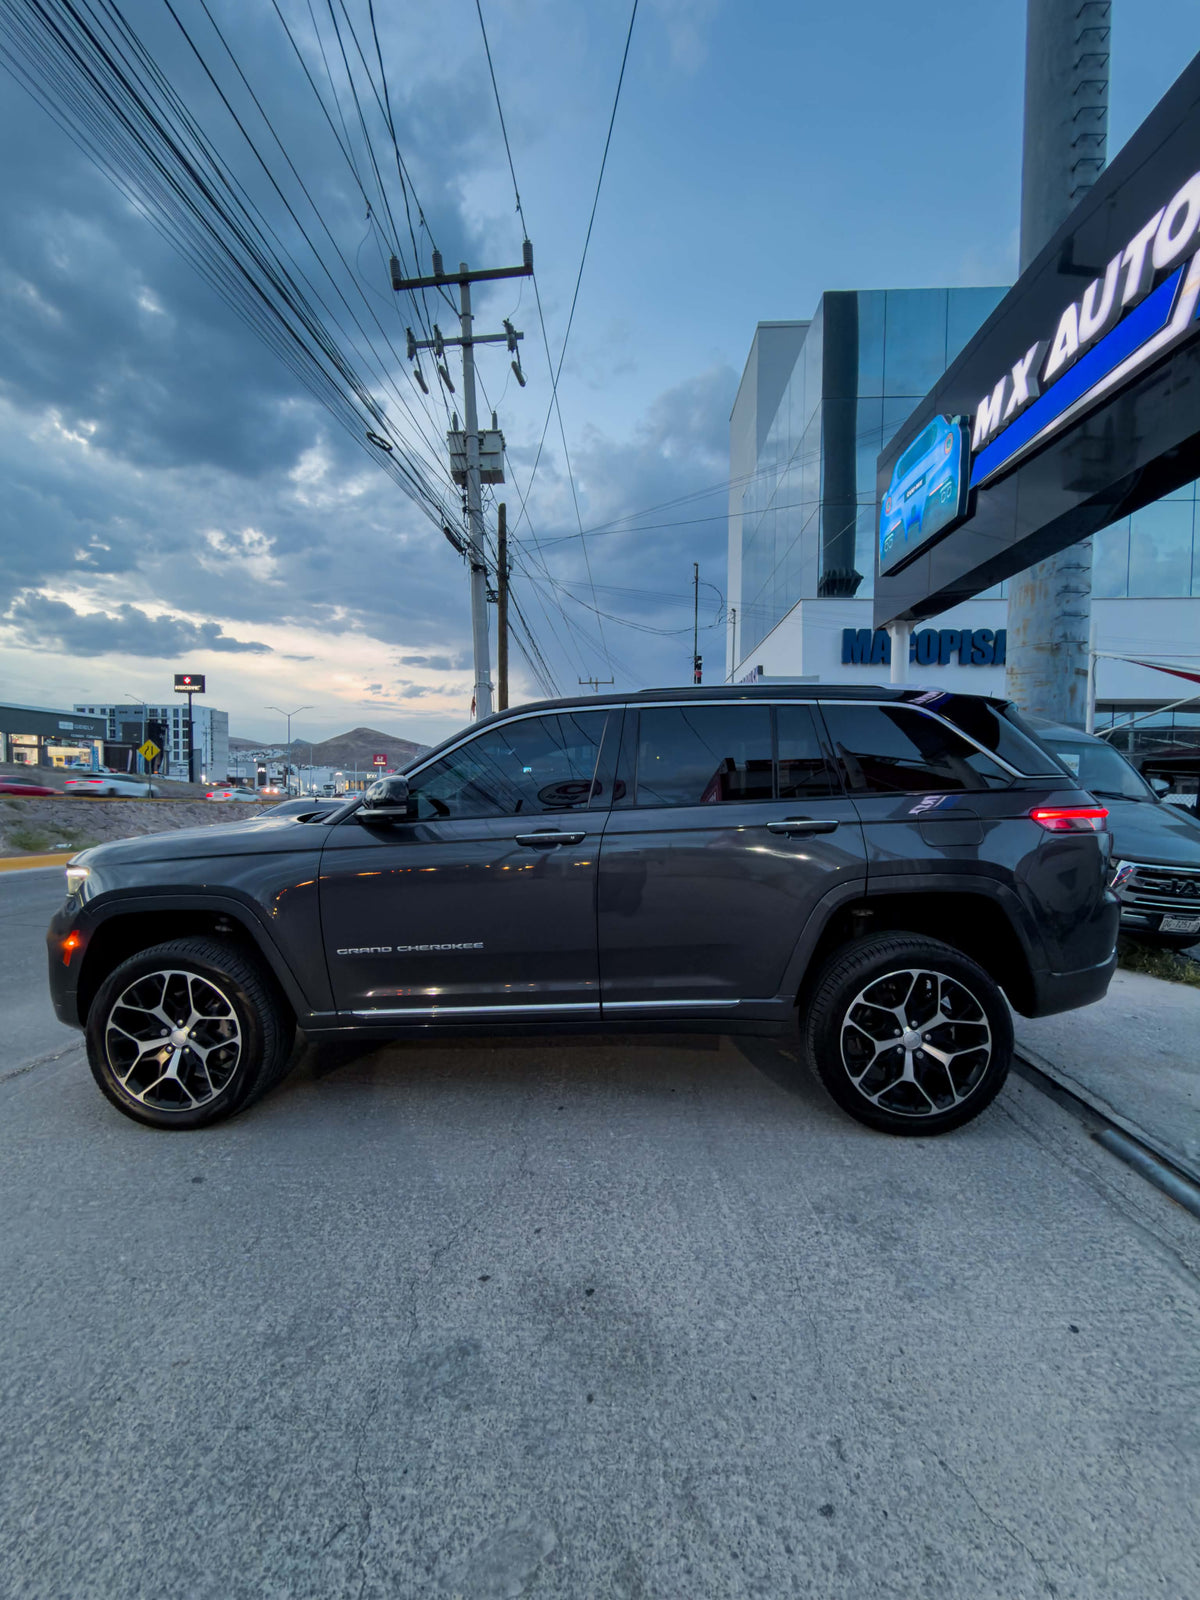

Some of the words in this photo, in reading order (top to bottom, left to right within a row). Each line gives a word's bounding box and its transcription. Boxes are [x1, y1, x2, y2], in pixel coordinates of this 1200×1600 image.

[971, 340, 1041, 452] MX
[1043, 171, 1200, 382] AUTO
[336, 946, 393, 955] GRAND
[396, 942, 484, 952] CHEROKEE
